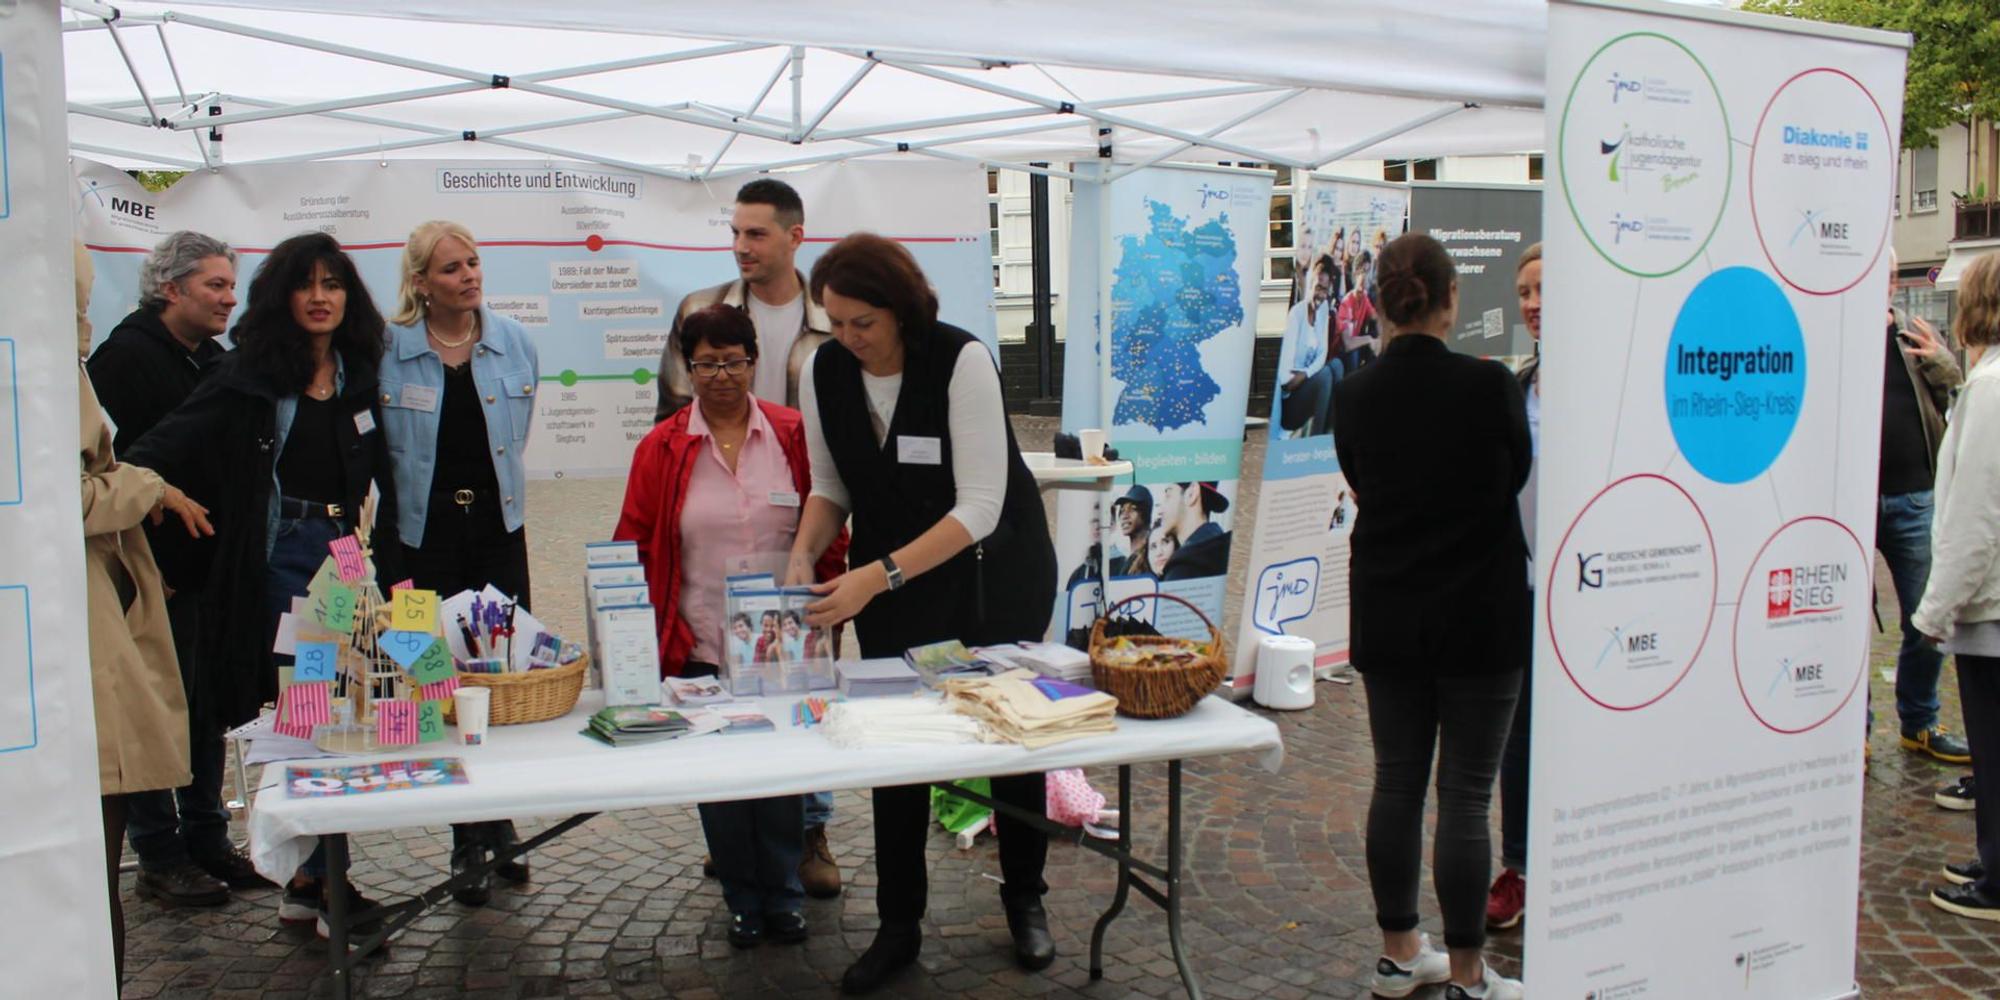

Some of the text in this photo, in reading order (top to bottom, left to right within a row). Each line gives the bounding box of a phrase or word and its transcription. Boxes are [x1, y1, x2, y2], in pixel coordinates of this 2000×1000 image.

[1783, 126, 1852, 148] Diakonie
[1823, 156, 1841, 168] und
[442, 171, 636, 198] Geschichte und Entwicklung
[111, 197, 156, 220] MBE
[1429, 229, 1521, 242] Migrationsberatung
[1820, 222, 1849, 240] MBE
[1678, 344, 1793, 381] Integration
[1672, 391, 1796, 421] im Rhein-Sieg-Kreis
[1794, 563, 1848, 587] RHEIN
[404, 593, 426, 620] 25
[1793, 585, 1834, 608] SIEG
[1628, 633, 1658, 653] MBE
[304, 649, 324, 676] 28
[1795, 664, 1823, 682] MBE
